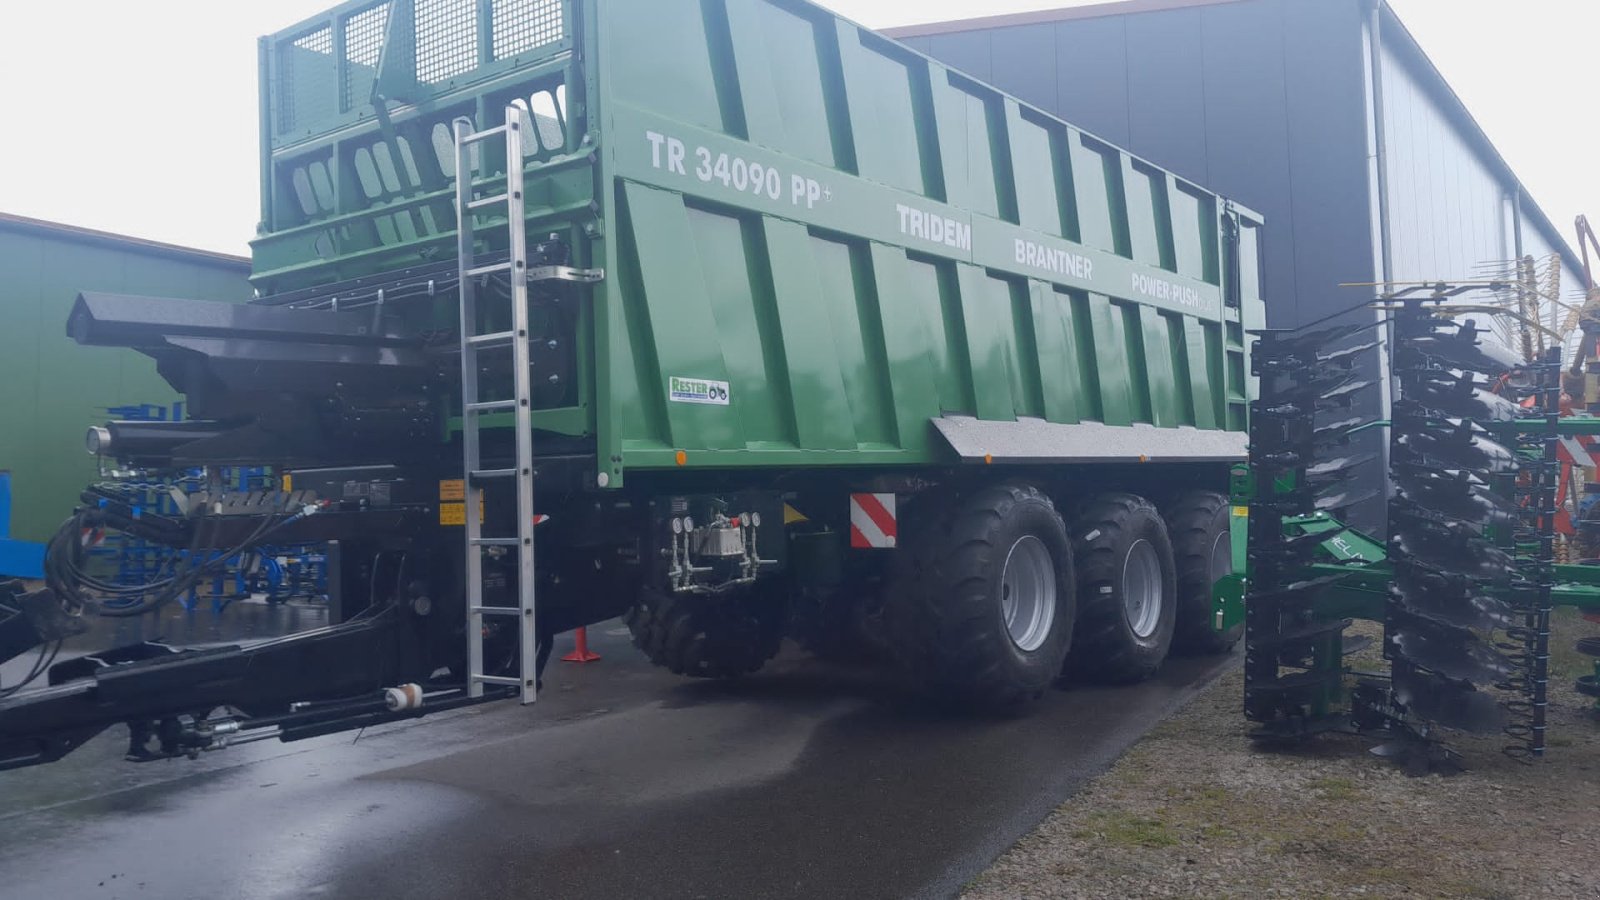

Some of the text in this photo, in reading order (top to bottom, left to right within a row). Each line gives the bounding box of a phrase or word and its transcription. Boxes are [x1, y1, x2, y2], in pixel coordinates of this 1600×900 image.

[646, 130, 687, 176] TR
[695, 146, 781, 201] 34090
[896, 203, 972, 251] TRIDEM
[1014, 238, 1093, 281] BRANTNER
